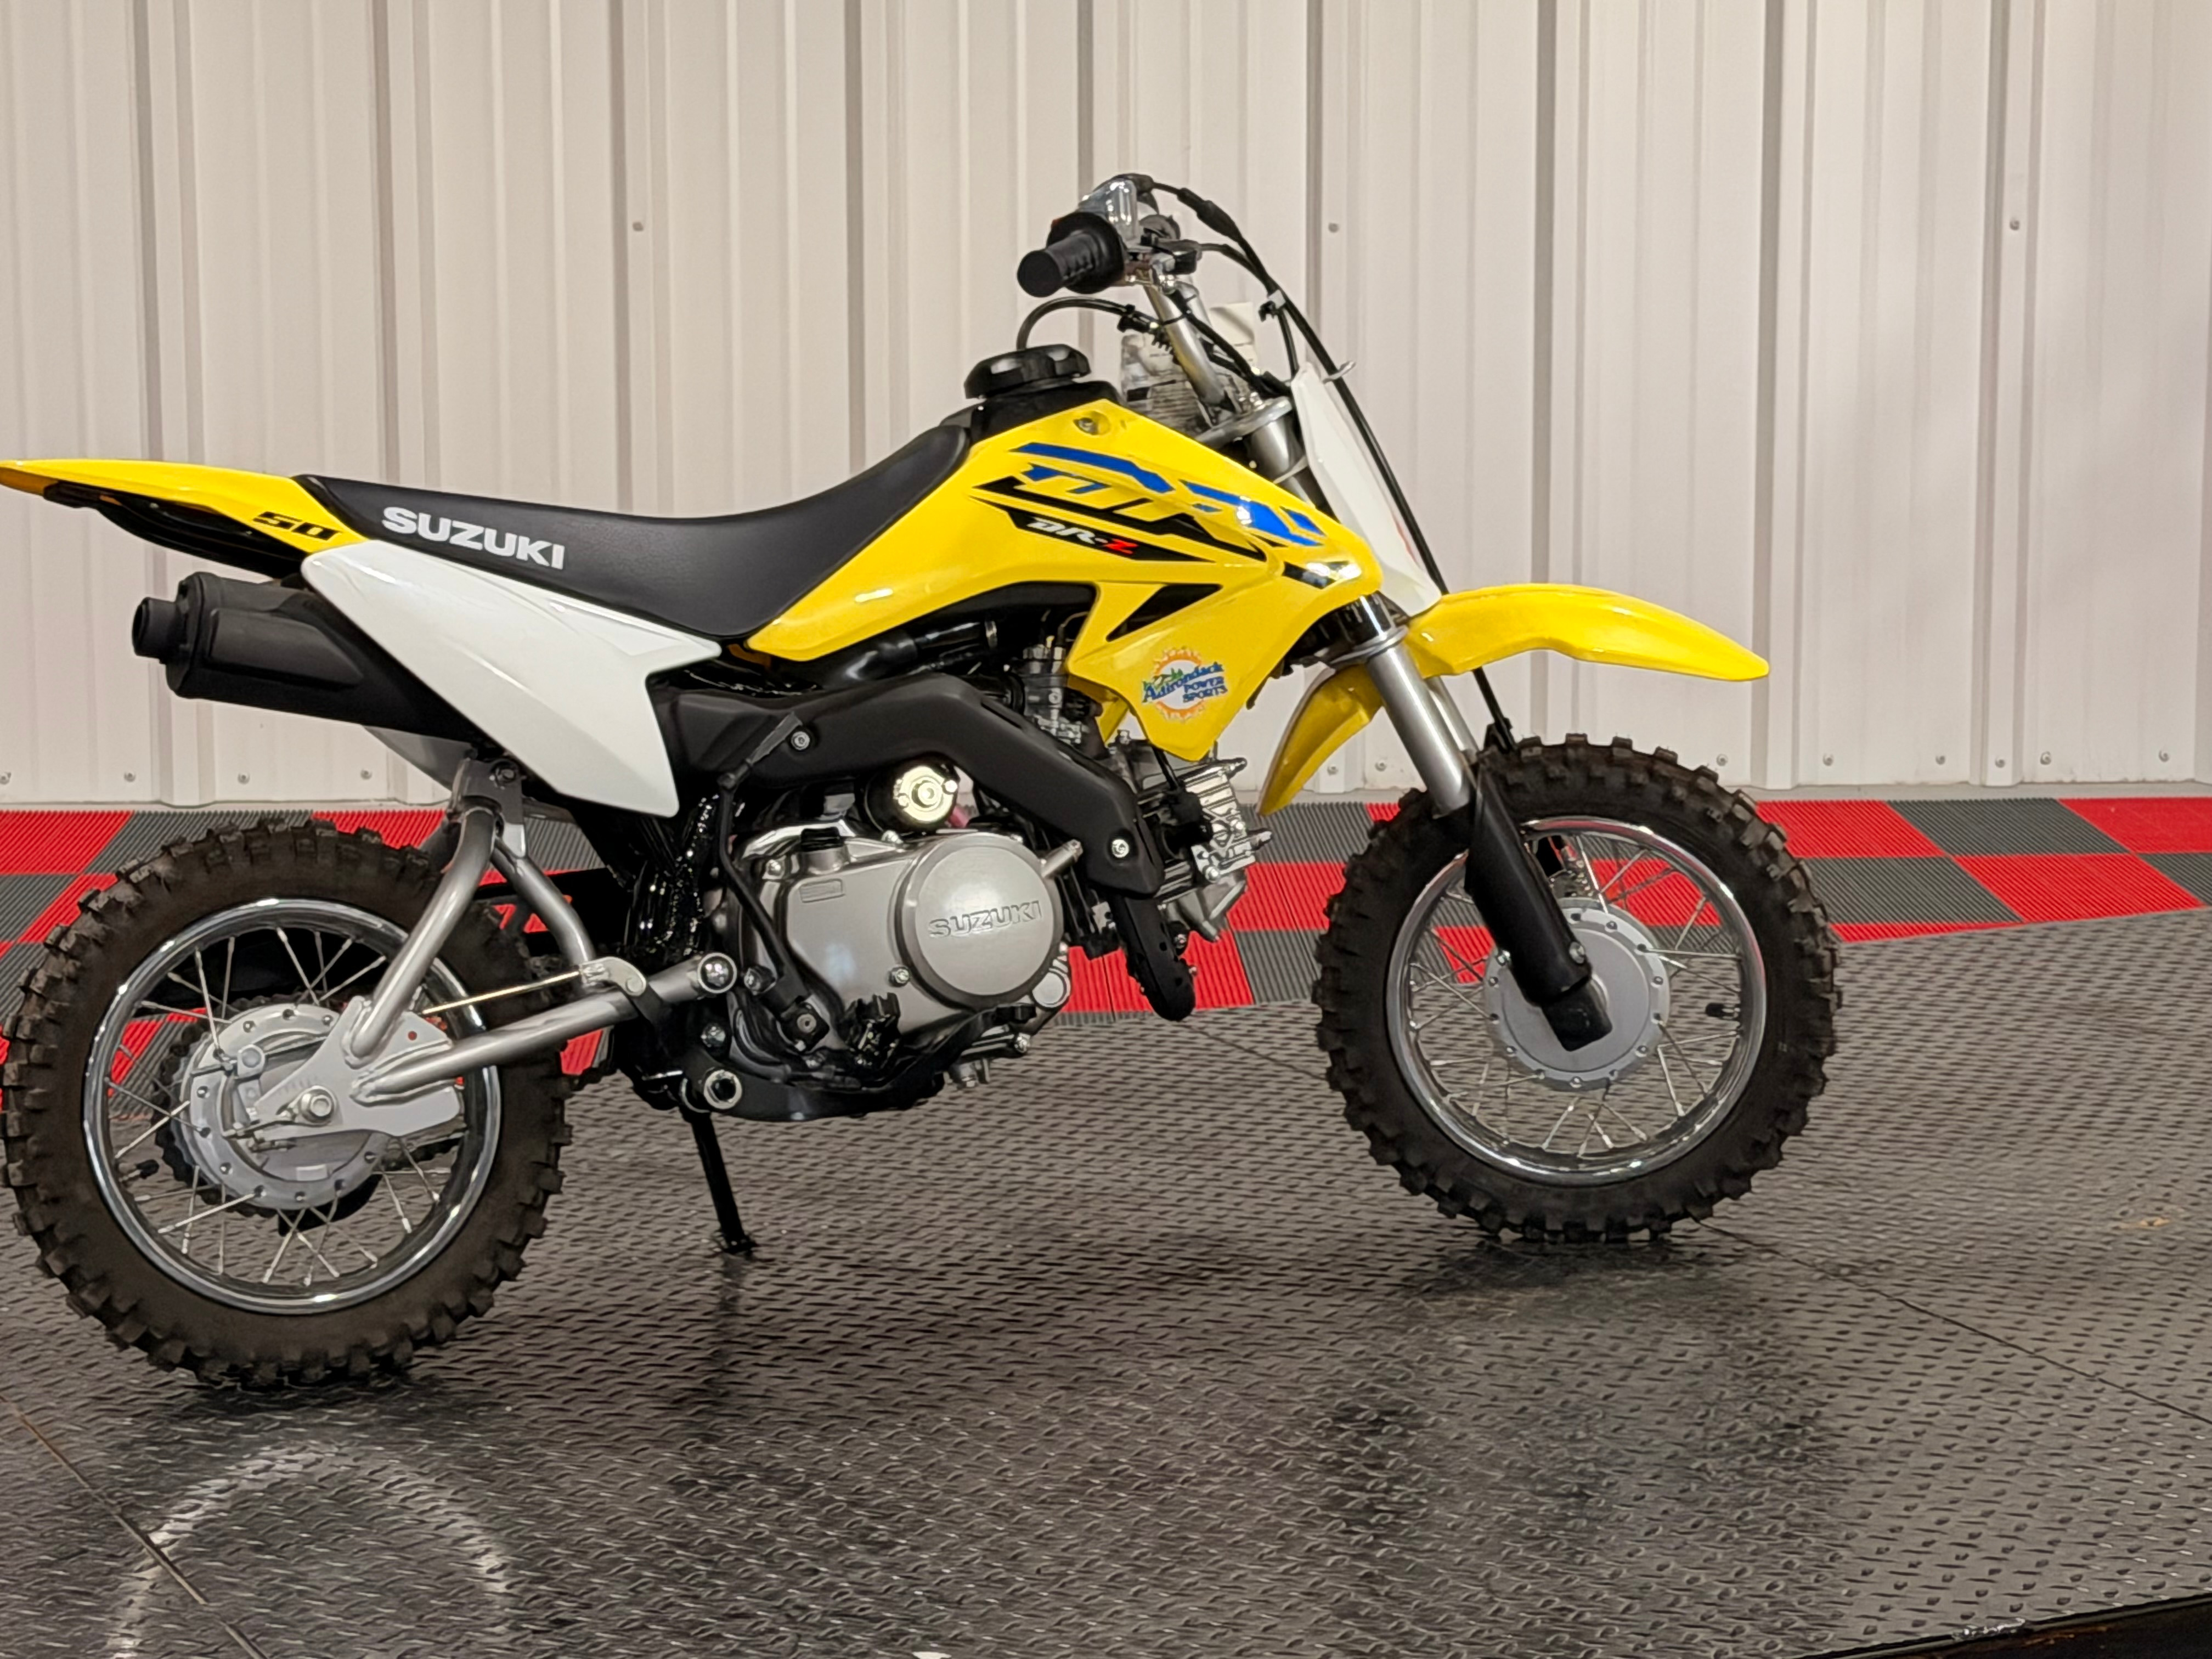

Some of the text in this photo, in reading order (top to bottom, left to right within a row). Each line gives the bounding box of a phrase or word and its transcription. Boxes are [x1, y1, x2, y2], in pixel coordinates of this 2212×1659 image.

[253, 511, 343, 541] 50
[382, 506, 565, 569] SUZUKI
[1026, 516, 1139, 555] DR-Z
[1142, 662, 1224, 703] Adirondack
[1182, 685, 1228, 703] SPORTS
[928, 900, 1042, 938] SUZUKI
